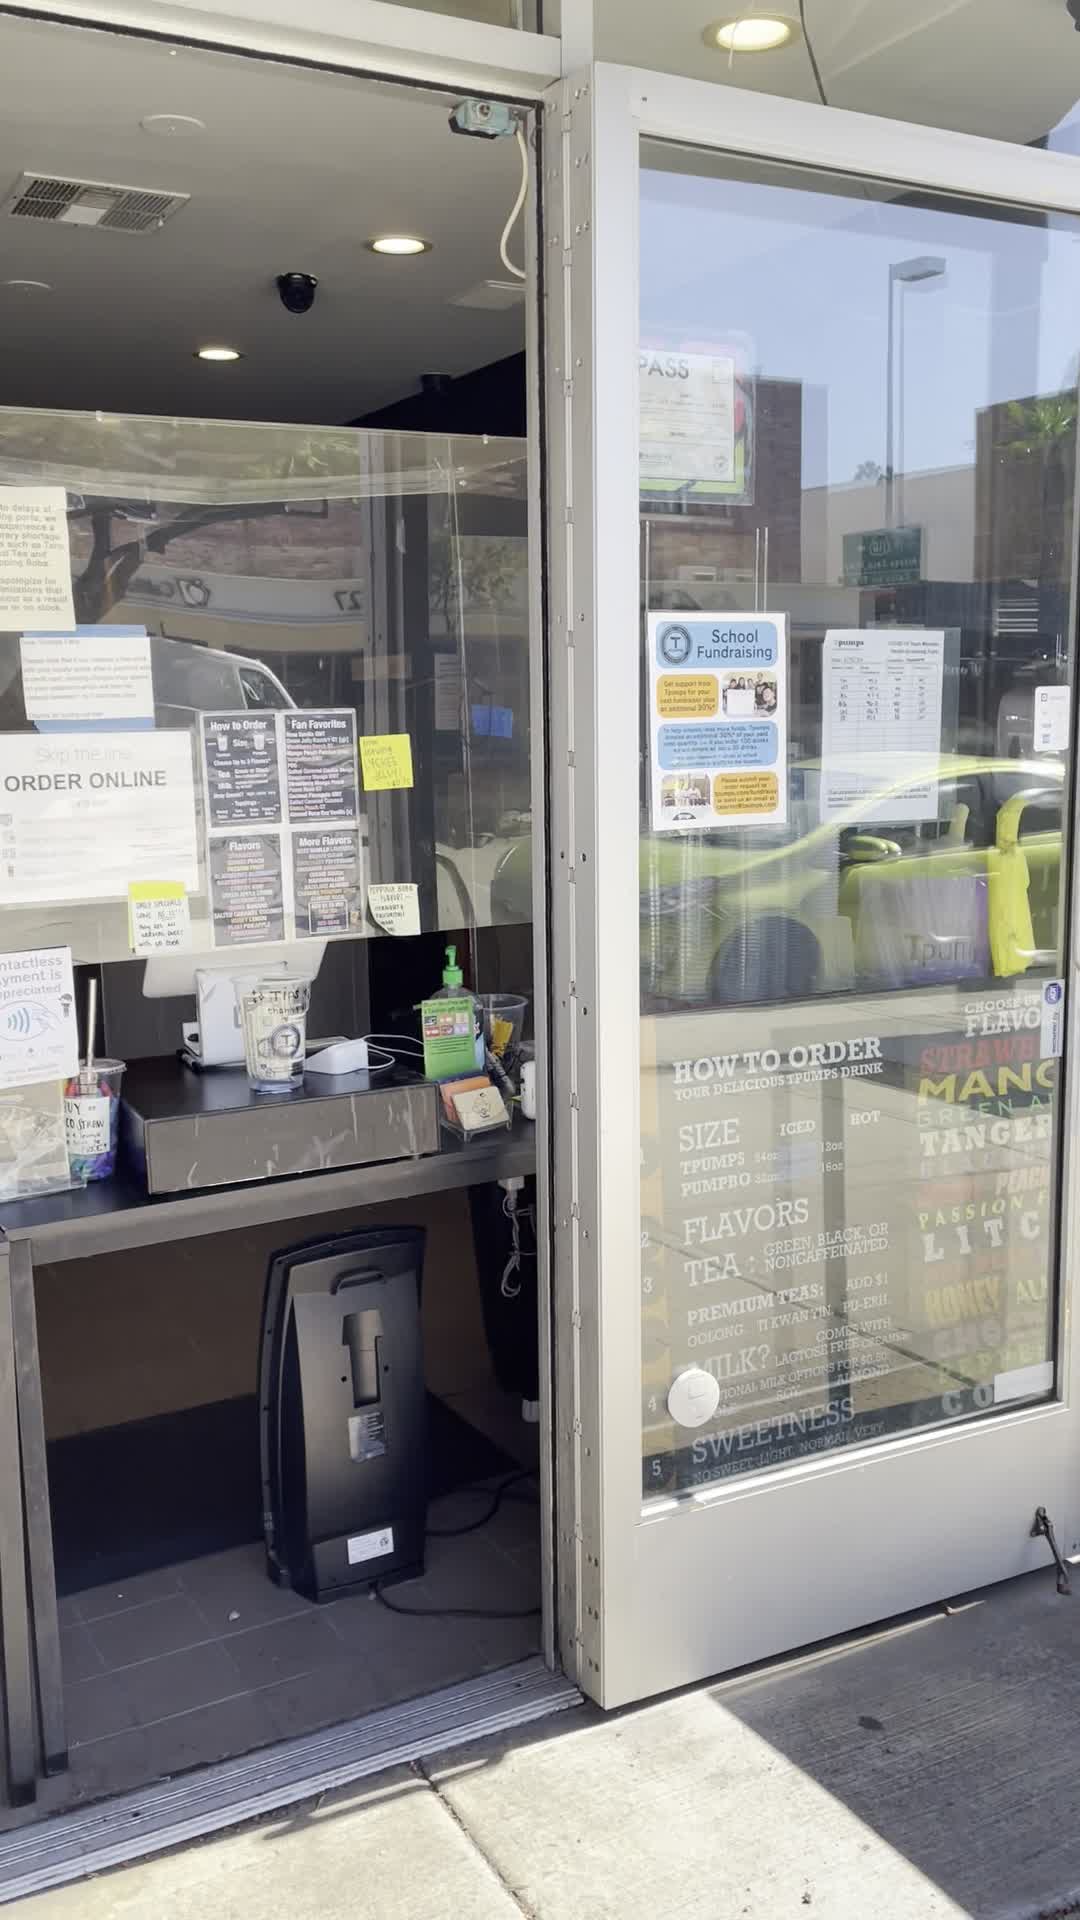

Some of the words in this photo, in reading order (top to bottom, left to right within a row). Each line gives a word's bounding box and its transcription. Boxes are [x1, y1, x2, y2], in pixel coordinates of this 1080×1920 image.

[711, 628, 759, 644] School
[697, 645, 773, 661] Fundraising
[210, 721, 231, 732] How
[232, 720, 242, 730] to
[243, 719, 268, 731] Order
[291, 720, 308, 730] Fan
[308, 719, 347, 730] Favorites
[36, 744, 70, 767] Skip
[4, 774, 83, 792] ORDER
[89, 770, 167, 789] ONLINE
[229, 842, 261, 851] Flavors
[299, 838, 320, 847] More
[321, 836, 352, 846] Flavors
[50, 968, 64, 981] is
[964, 998, 1023, 1014] CHOOSE
[672, 1054, 740, 1084] HOW
[743, 1050, 781, 1075] TO
[788, 1037, 884, 1068] ORDER
[674, 1084, 710, 1101] YOUR
[714, 1075, 785, 1096] DELICIOUS
[786, 1067, 838, 1085] TPUMPS
[840, 1062, 884, 1078] DRINK
[679, 1118, 740, 1152] SIZE
[780, 1119, 816, 1137] ICED
[850, 1110, 881, 1126] HOT
[680, 1152, 746, 1176] TPUMPS
[680, 1172, 751, 1197] PUMPRO
[682, 1198, 810, 1246] FLAVORS
[918, 1195, 1024, 1230] PASSION
[868, 1222, 889, 1236] OR
[922, 1210, 1041, 1264] LITC
[764, 1237, 889, 1273] NONCAFFEINATED
[684, 1252, 742, 1287] TEA
[642, 1276, 653, 1294] 3
[687, 1293, 776, 1327] PREMIUM
[777, 1282, 825, 1306] TEAS:
[687, 1324, 745, 1348] OOLONG
[815, 1325, 859, 1344] COMES
[775, 1341, 828, 1367] LACTOSE
[787, 1366, 835, 1384] OPTIONS
[652, 1459, 662, 1476] 5
[691, 1396, 856, 1466] SWEETNESS
